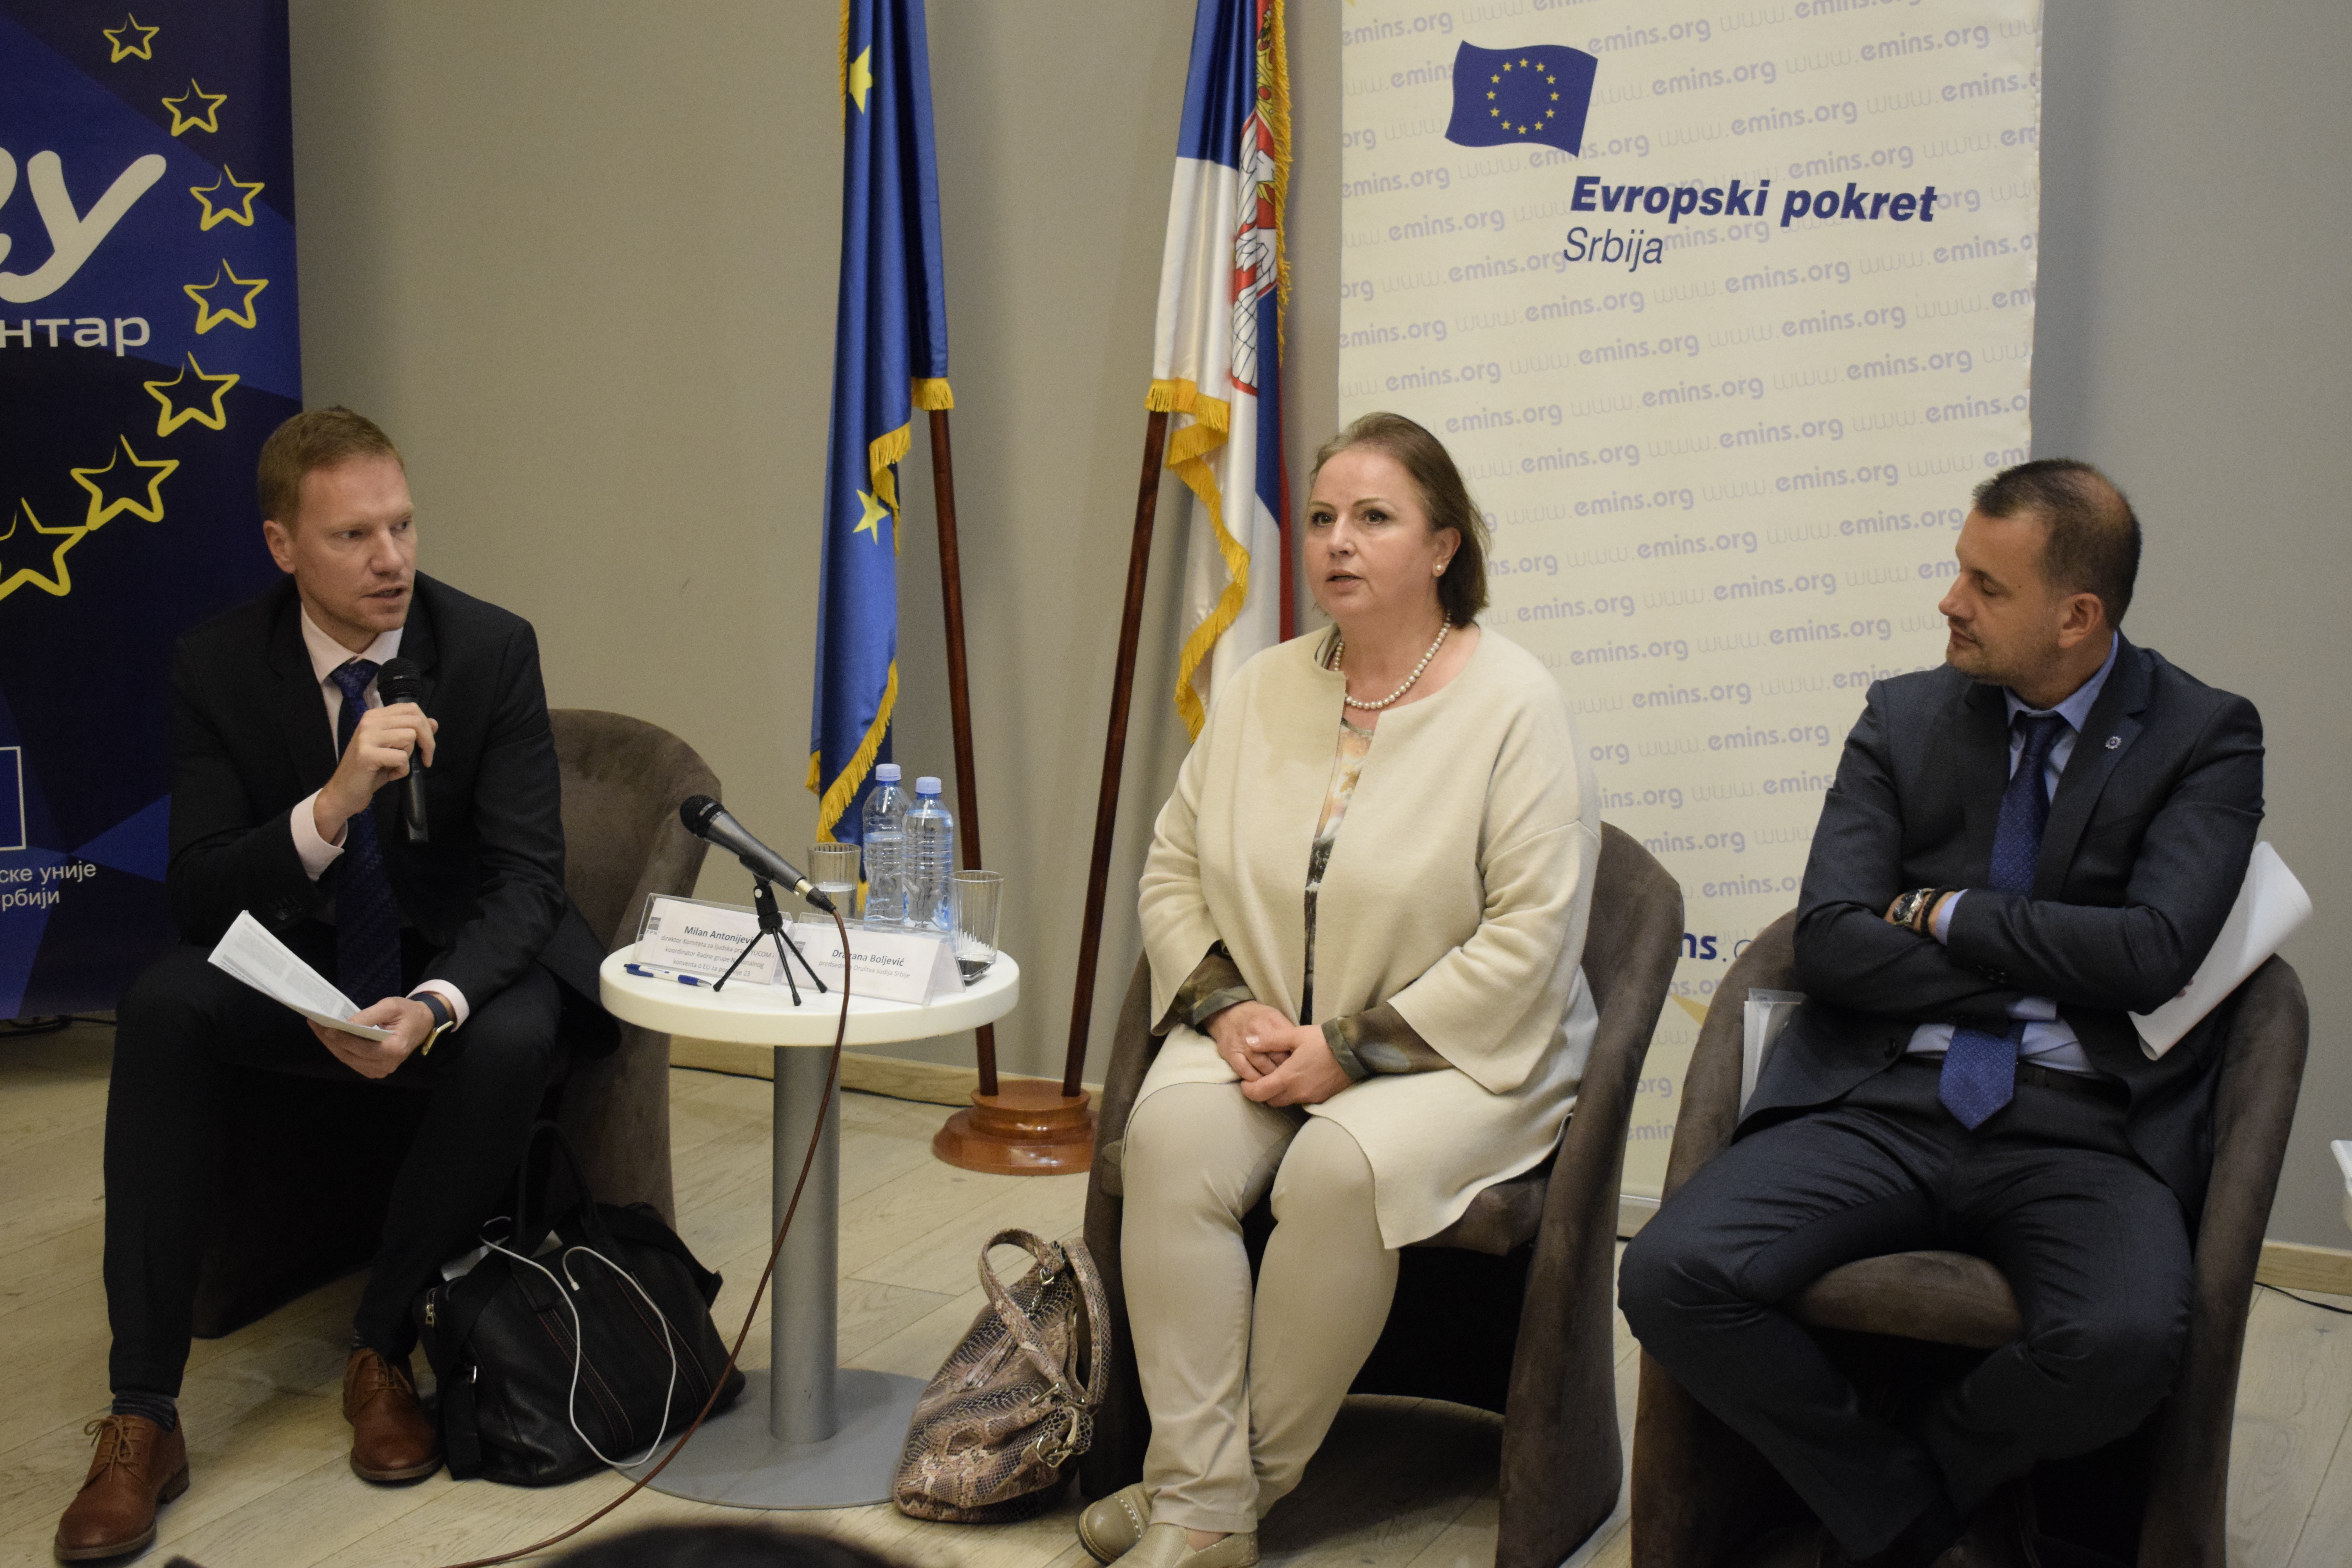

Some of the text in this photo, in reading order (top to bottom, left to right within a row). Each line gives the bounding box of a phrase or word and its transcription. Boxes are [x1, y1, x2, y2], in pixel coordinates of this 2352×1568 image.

[1570, 176, 1770, 224] Evropski
[1780, 183, 1938, 227] pokret
[1563, 227, 1663, 273] Srbija
[40, 860, 96, 885] уније
[684, 926, 755, 944] Milan Antonijevi
[661, 935, 682, 944] direktor
[682, 939, 706, 947] Komiteta
[715, 943, 733, 951] ljudska
[750, 950, 773, 958] YUCOM
[665, 946, 695, 956] koordinator
[673, 959, 697, 968] konventa
[832, 949, 905, 967] Draana Boljević
[853, 965, 875, 973] Društva
[894, 971, 911, 979] Srbije
